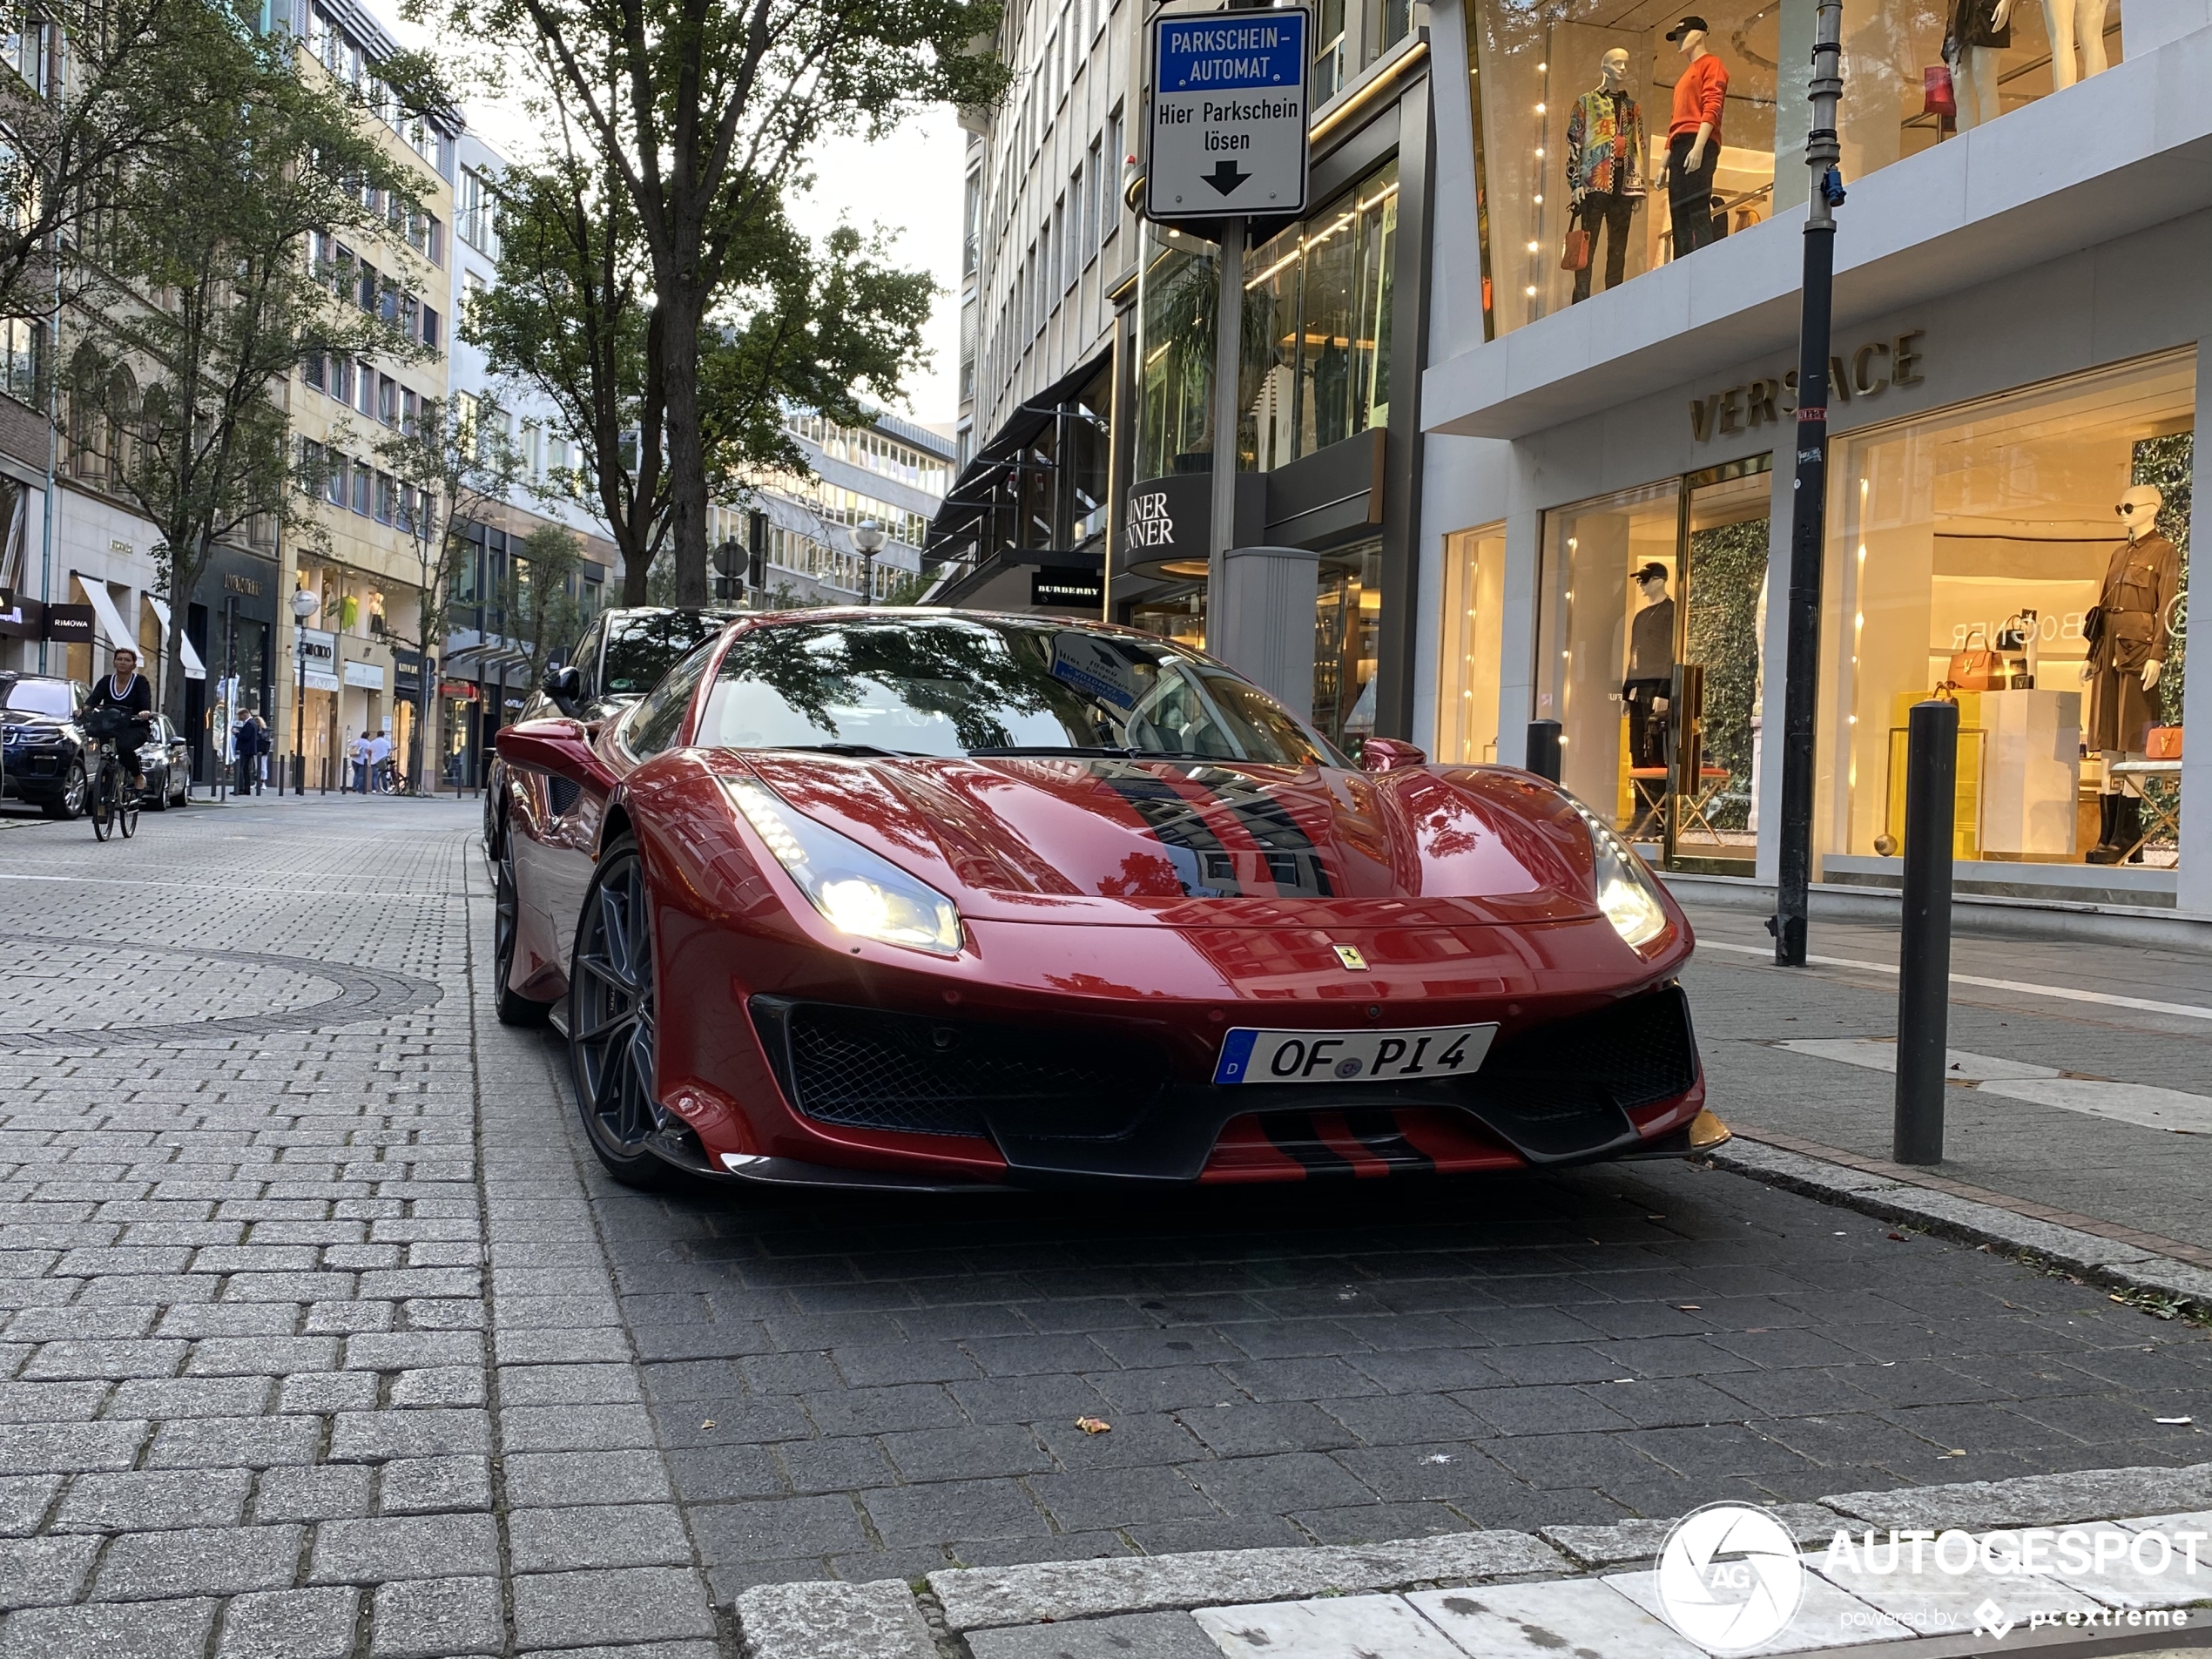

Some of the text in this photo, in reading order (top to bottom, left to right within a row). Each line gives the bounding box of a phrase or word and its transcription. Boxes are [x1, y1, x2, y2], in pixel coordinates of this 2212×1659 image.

[1171, 27, 1291, 53] PARKSCHEIN-
[1190, 57, 1271, 82] AUTOMAT
[1159, 98, 1298, 125] Hier Parkschein
[1204, 131, 1250, 151] lösen
[1038, 585, 1099, 596] BURBERRY
[54, 618, 88, 628] RIMOWA
[1226, 1062, 1238, 1075] D
[1271, 1038, 1345, 1077] OF
